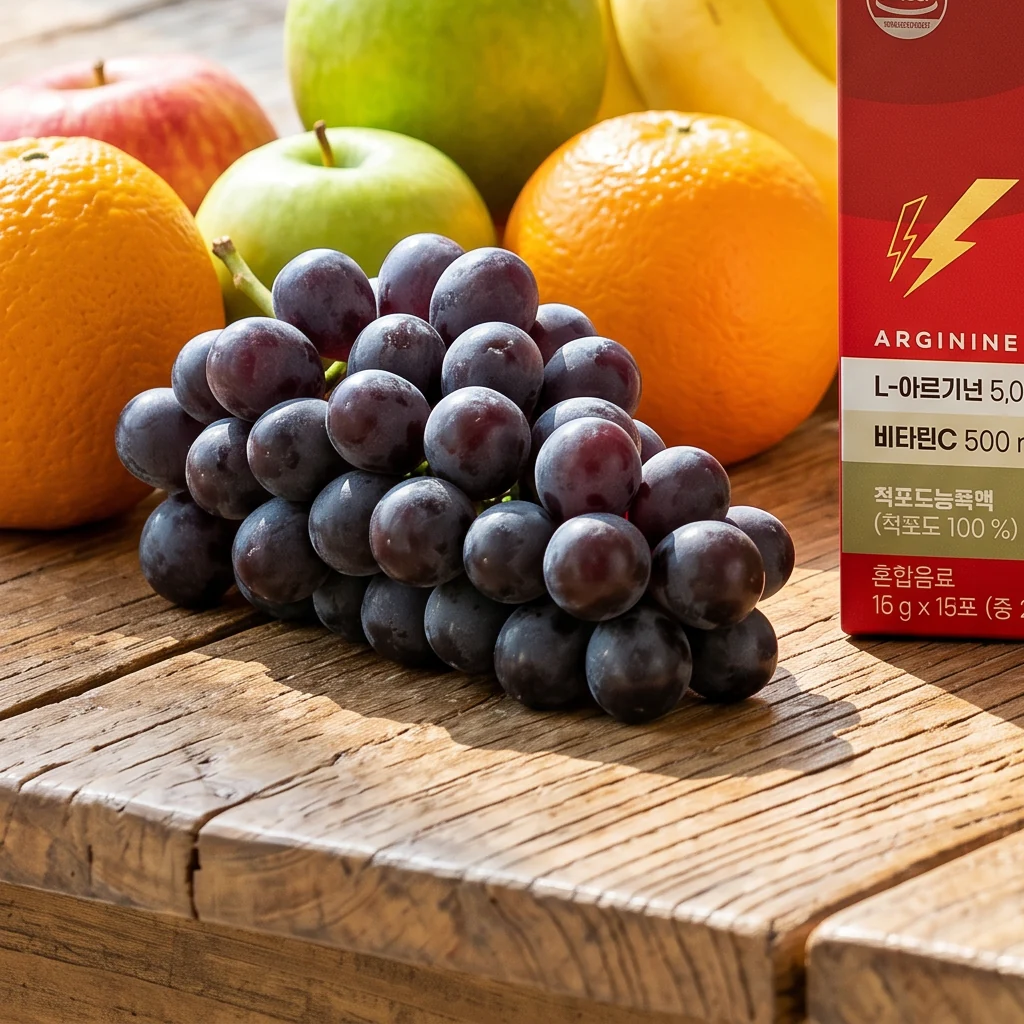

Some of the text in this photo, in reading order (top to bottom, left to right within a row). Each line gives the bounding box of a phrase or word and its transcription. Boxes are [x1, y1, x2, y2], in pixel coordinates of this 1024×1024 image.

[874, 329, 1018, 352] ARGININE
[964, 429, 1010, 453] 500
[947, 517, 985, 539] 100
[991, 517, 1018, 541] %)
[871, 564, 956, 589] 혼합음료
[872, 594, 894, 615] 16
[899, 600, 911, 622] g
[918, 601, 930, 616] x
[935, 596, 978, 617] 15포
